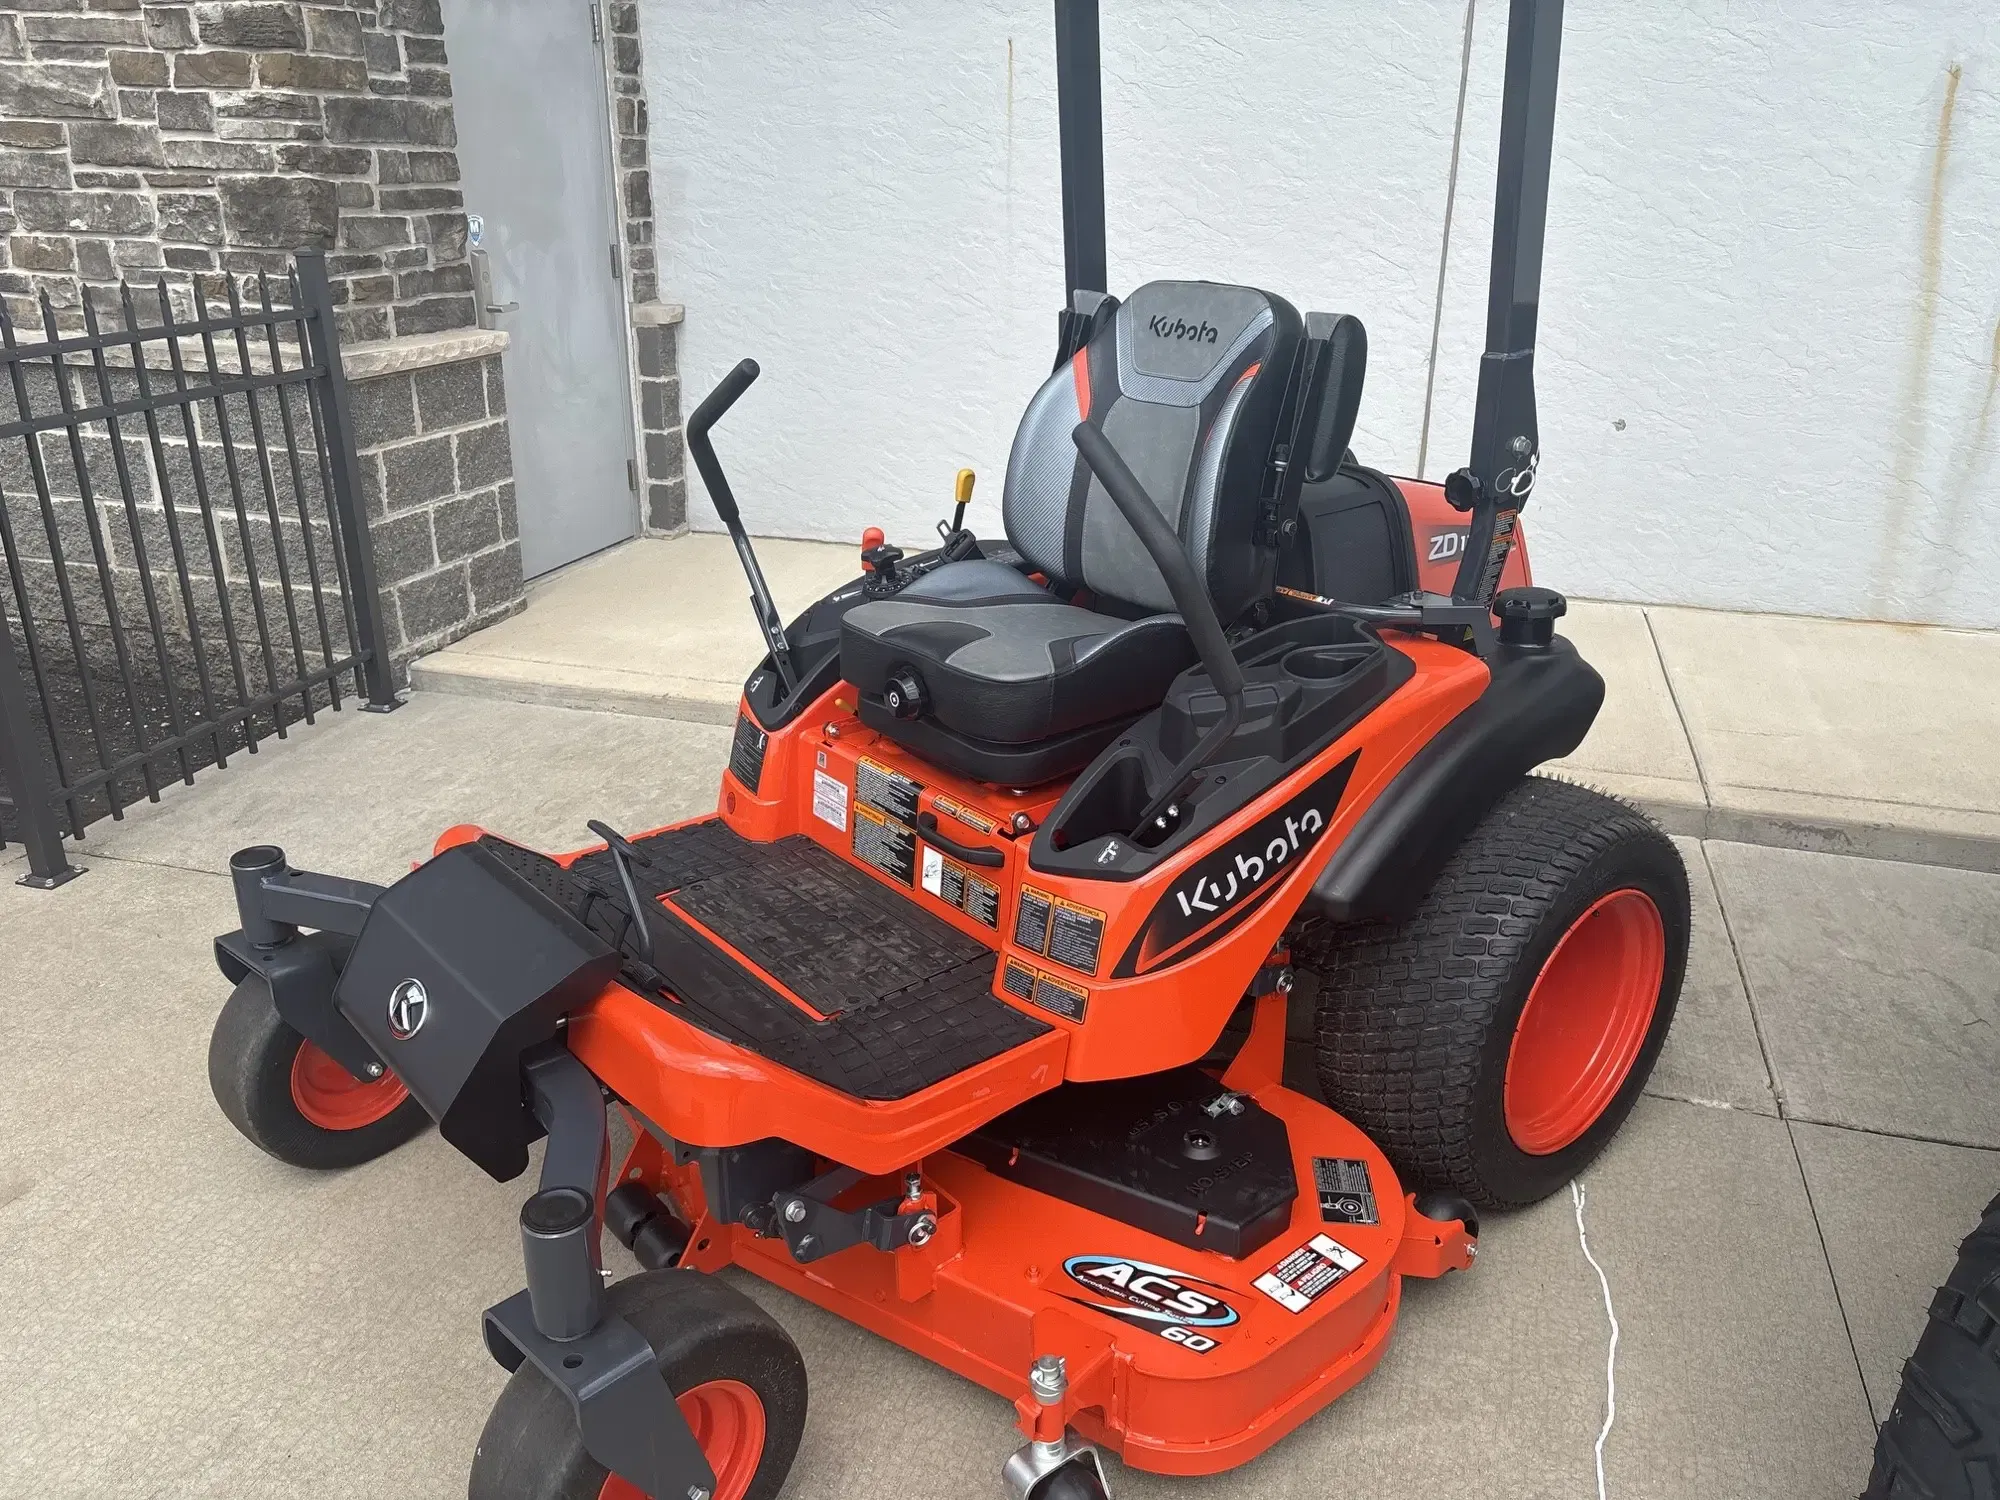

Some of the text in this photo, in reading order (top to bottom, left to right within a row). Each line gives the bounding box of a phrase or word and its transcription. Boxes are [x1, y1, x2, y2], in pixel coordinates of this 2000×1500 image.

[1149, 315, 1219, 344] Kubota
[1428, 533, 1470, 562] ZD1
[1176, 808, 1323, 917] Kubota
[1076, 1275, 1127, 1299] Aerodynamic
[1128, 1295, 1161, 1312] Cutting
[1083, 1262, 1219, 1315] ACS
[1160, 1326, 1215, 1351] 60
